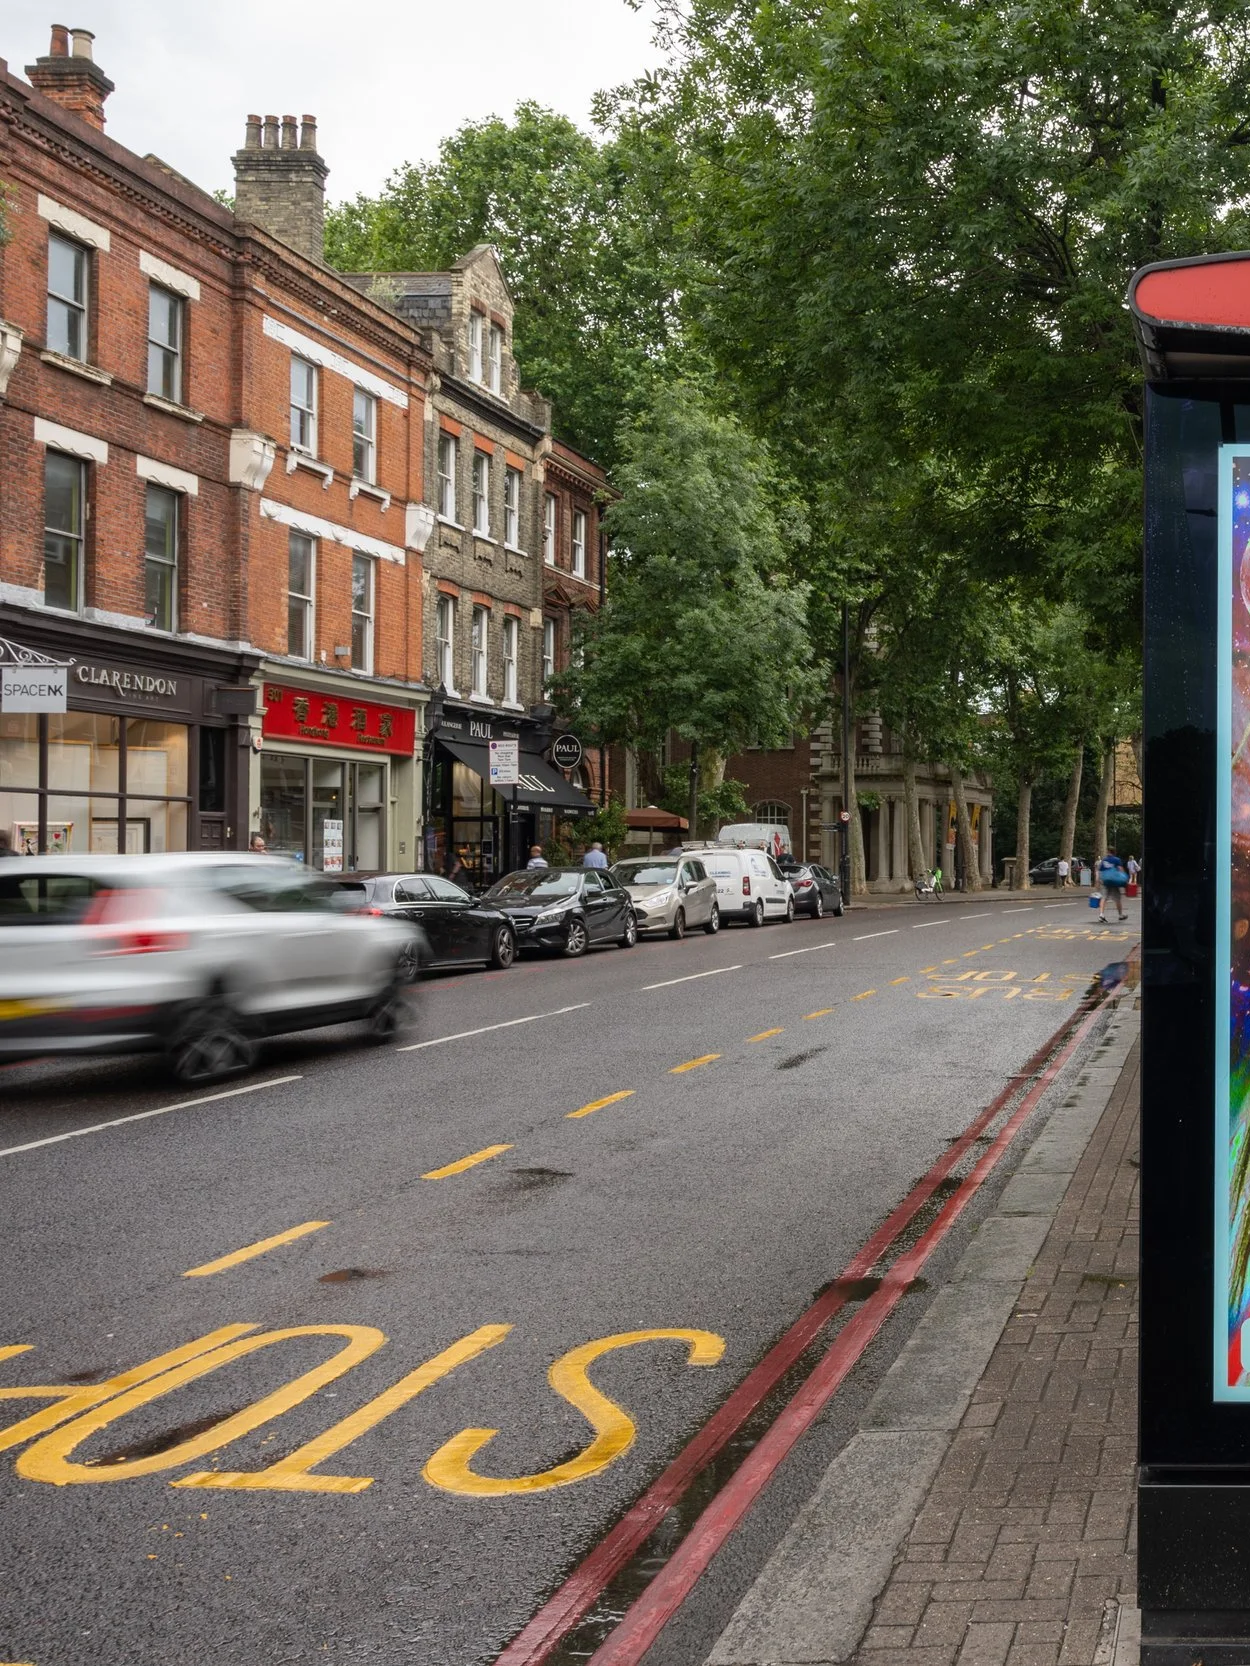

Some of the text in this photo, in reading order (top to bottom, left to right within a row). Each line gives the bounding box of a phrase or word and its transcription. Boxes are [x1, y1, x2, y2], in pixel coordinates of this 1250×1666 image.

[77, 665, 177, 696] CLARENDON
[470, 721, 493, 740] PAUL
[556, 744, 579, 753] PAUL
[927, 970, 1103, 983] STOP
[916, 985, 1075, 1000] BUS
